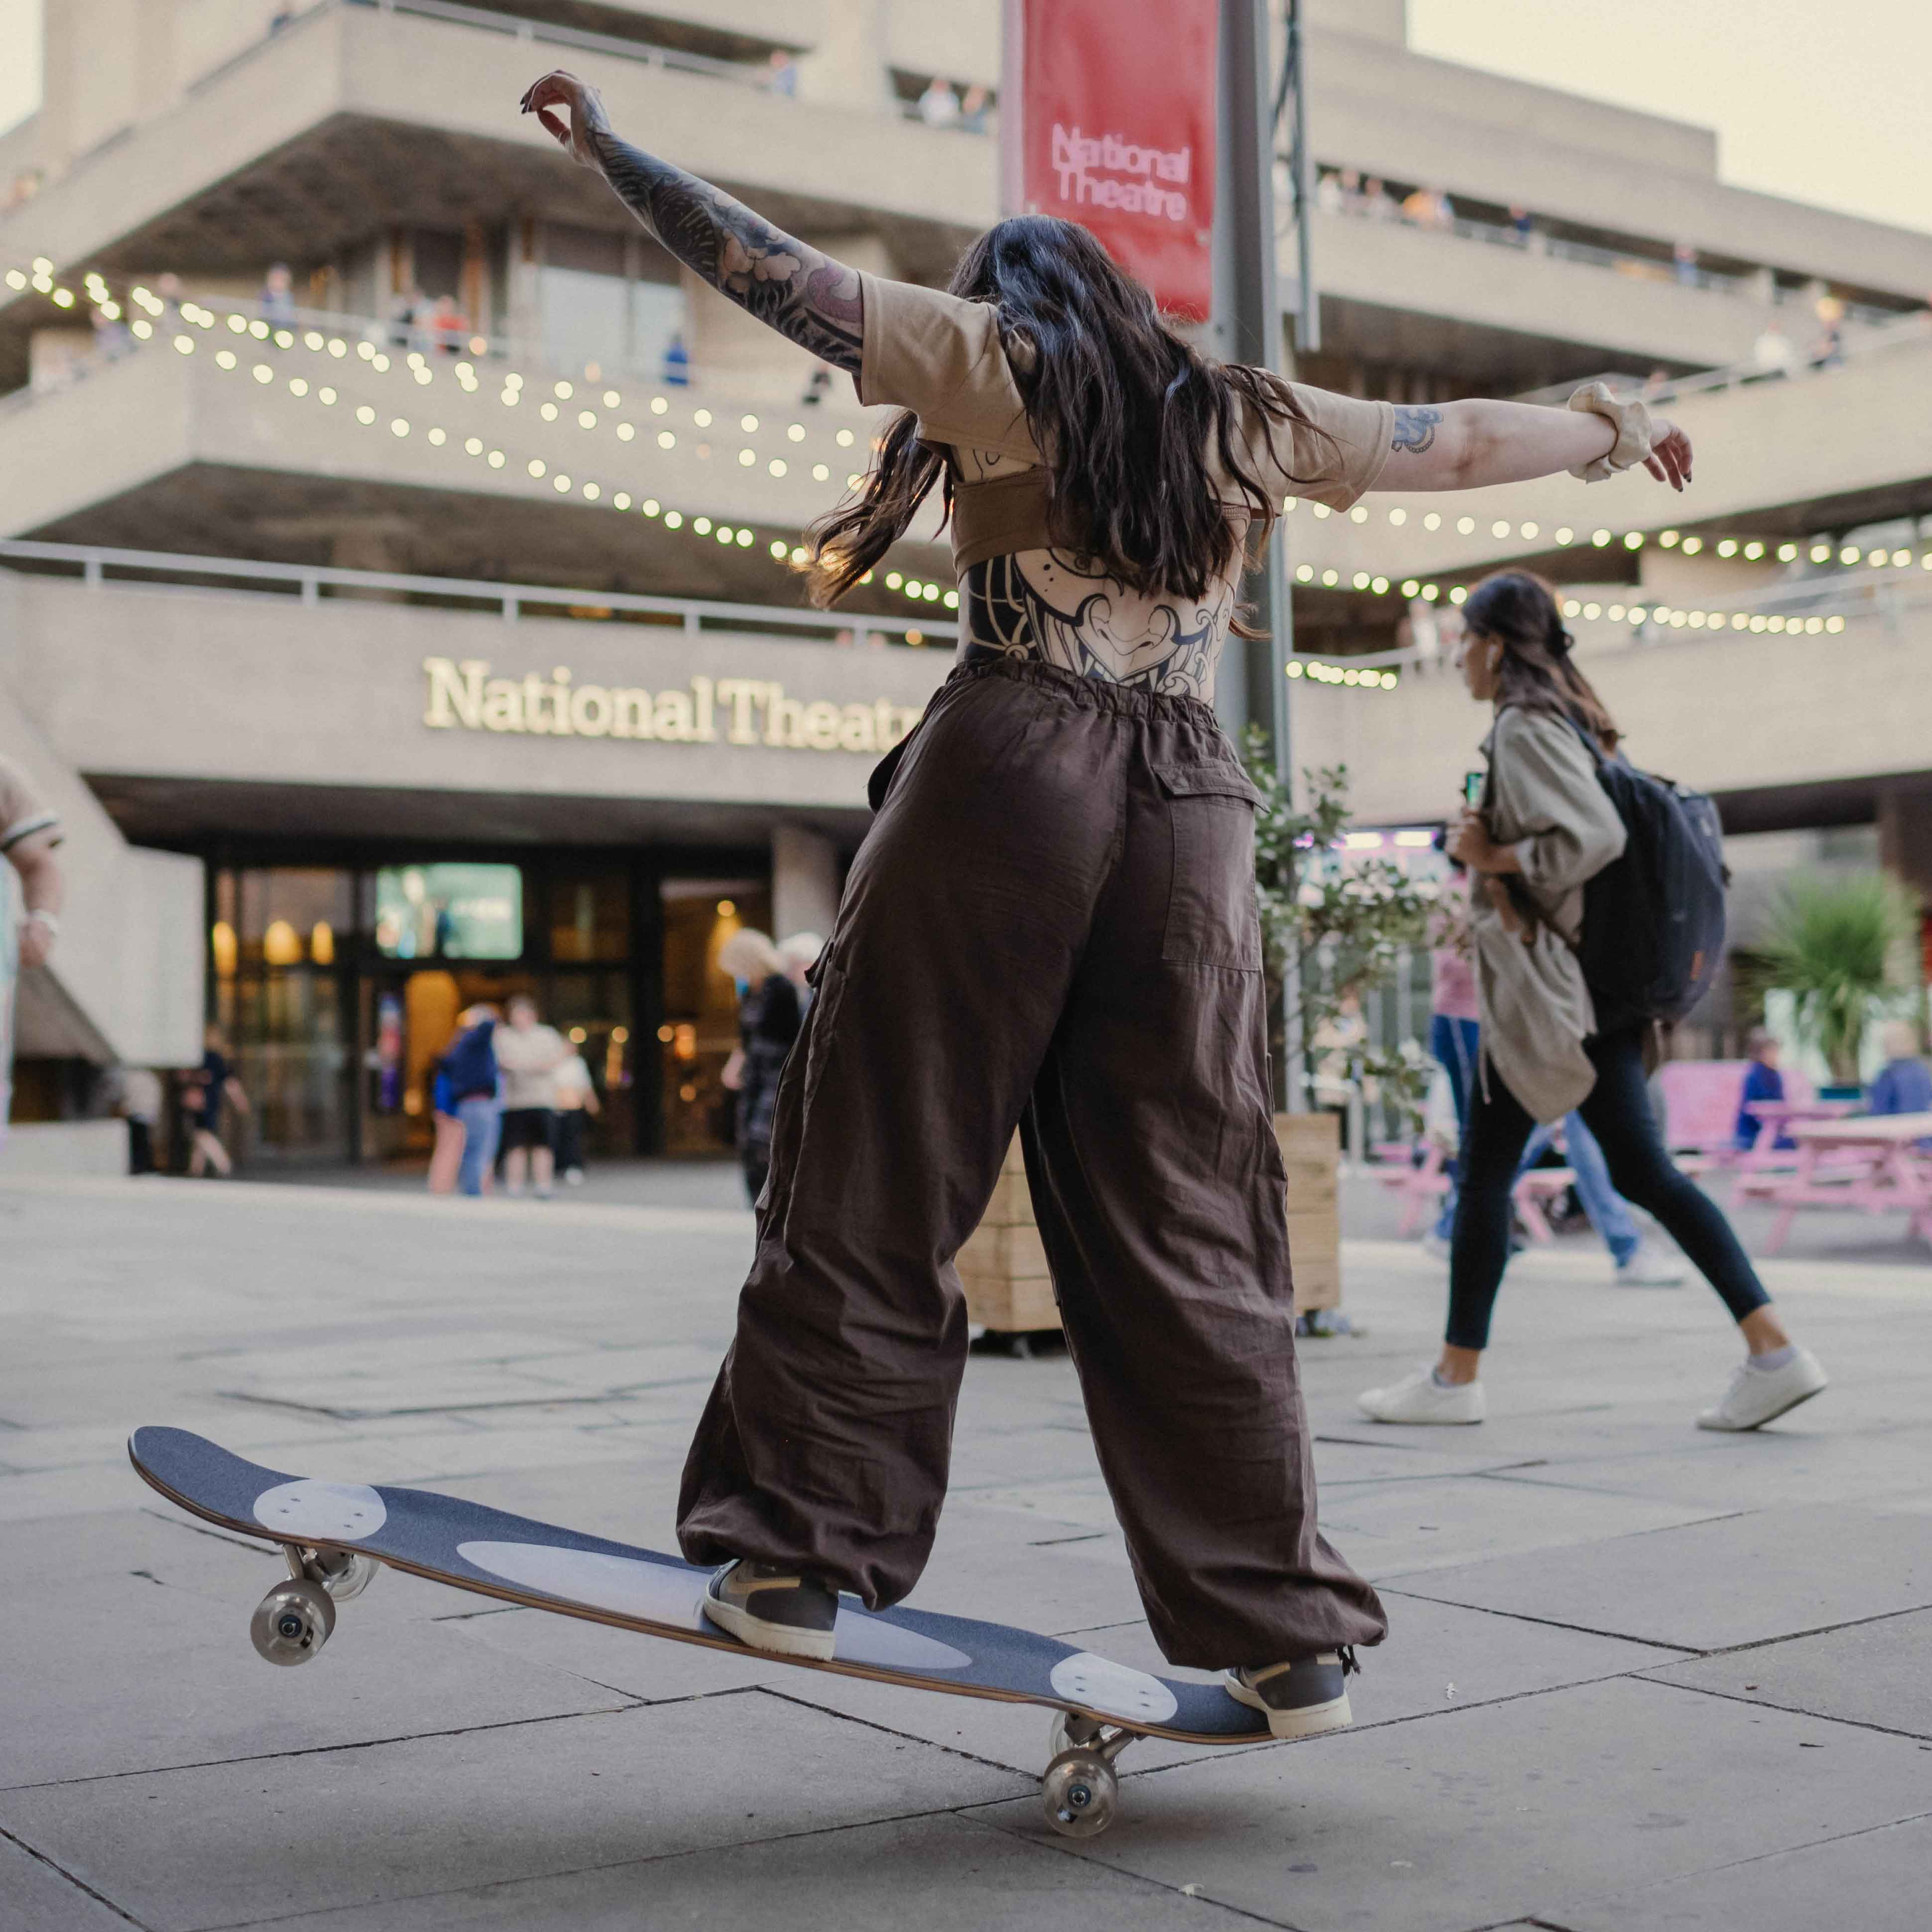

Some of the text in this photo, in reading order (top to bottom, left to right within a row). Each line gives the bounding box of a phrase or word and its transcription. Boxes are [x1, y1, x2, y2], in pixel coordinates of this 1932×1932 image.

[1051, 123, 1190, 184] National
[1058, 168, 1187, 221] Theatre
[423, 656, 717, 743] National
